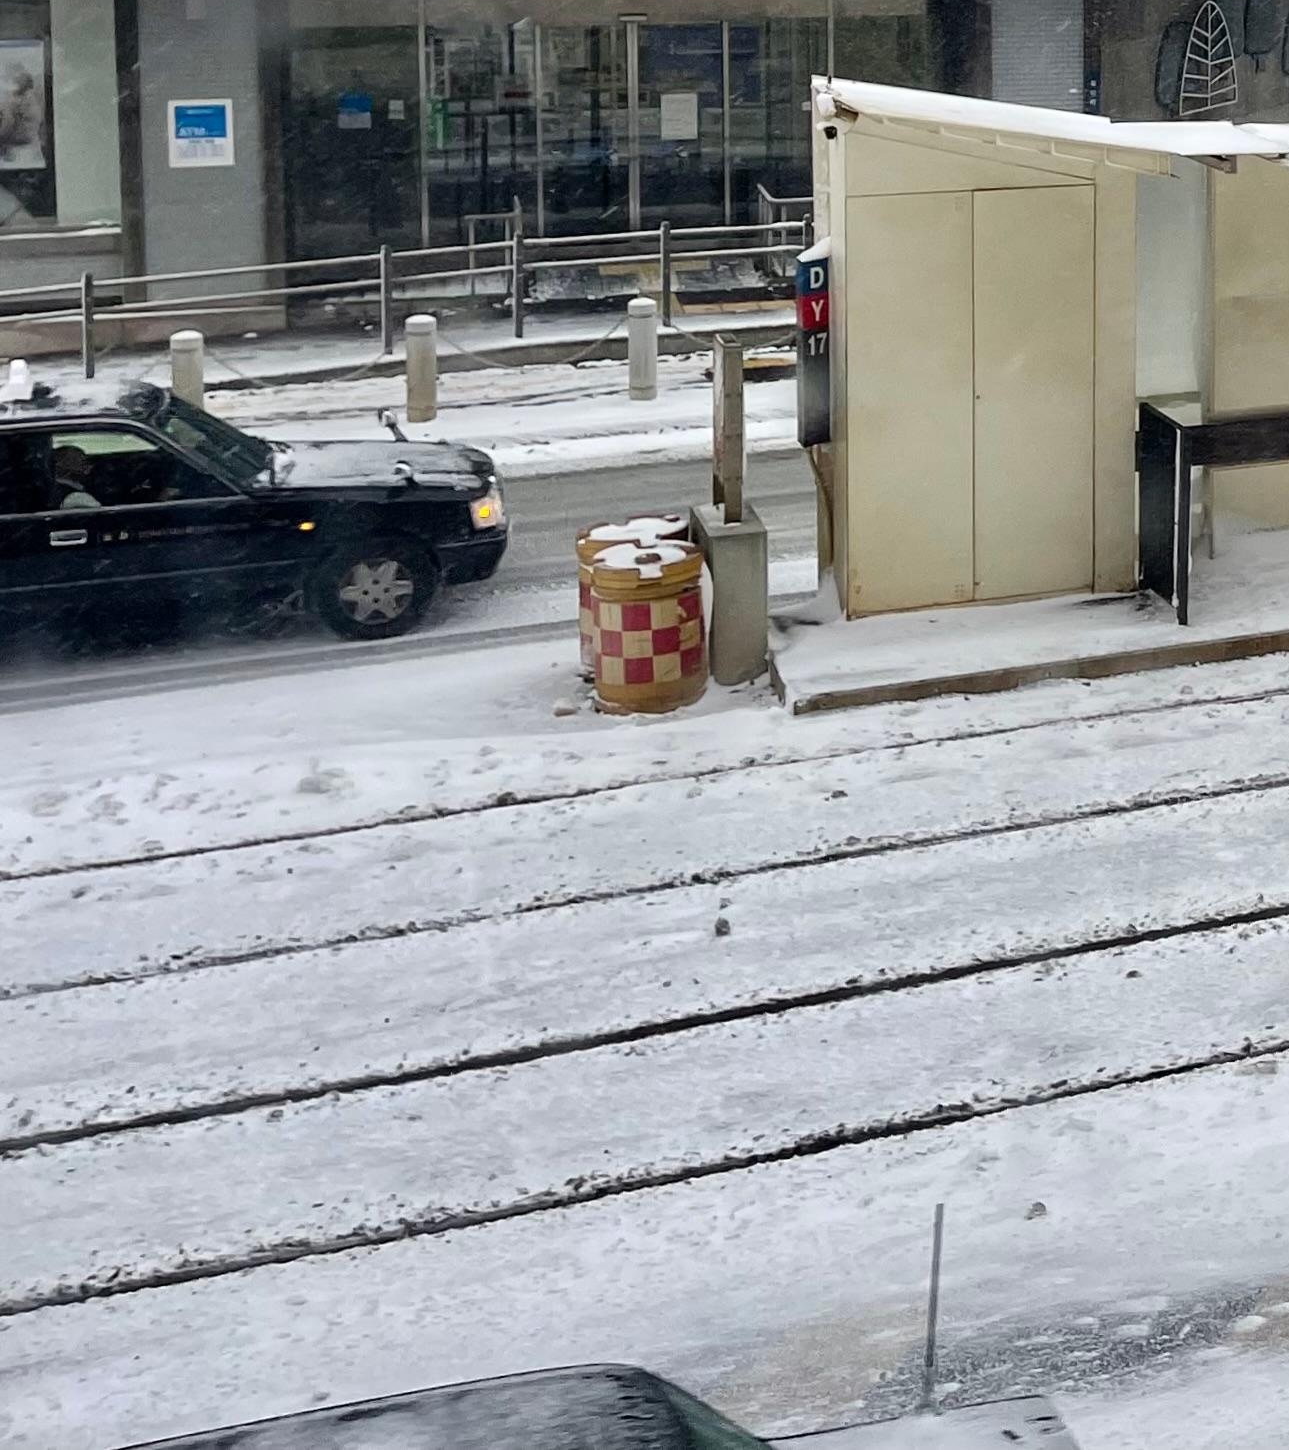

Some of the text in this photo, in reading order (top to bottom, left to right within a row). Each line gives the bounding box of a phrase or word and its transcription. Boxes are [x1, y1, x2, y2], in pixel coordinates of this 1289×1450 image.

[809, 266, 824, 289] D
[811, 300, 825, 321] Y
[808, 333, 827, 356] 17
